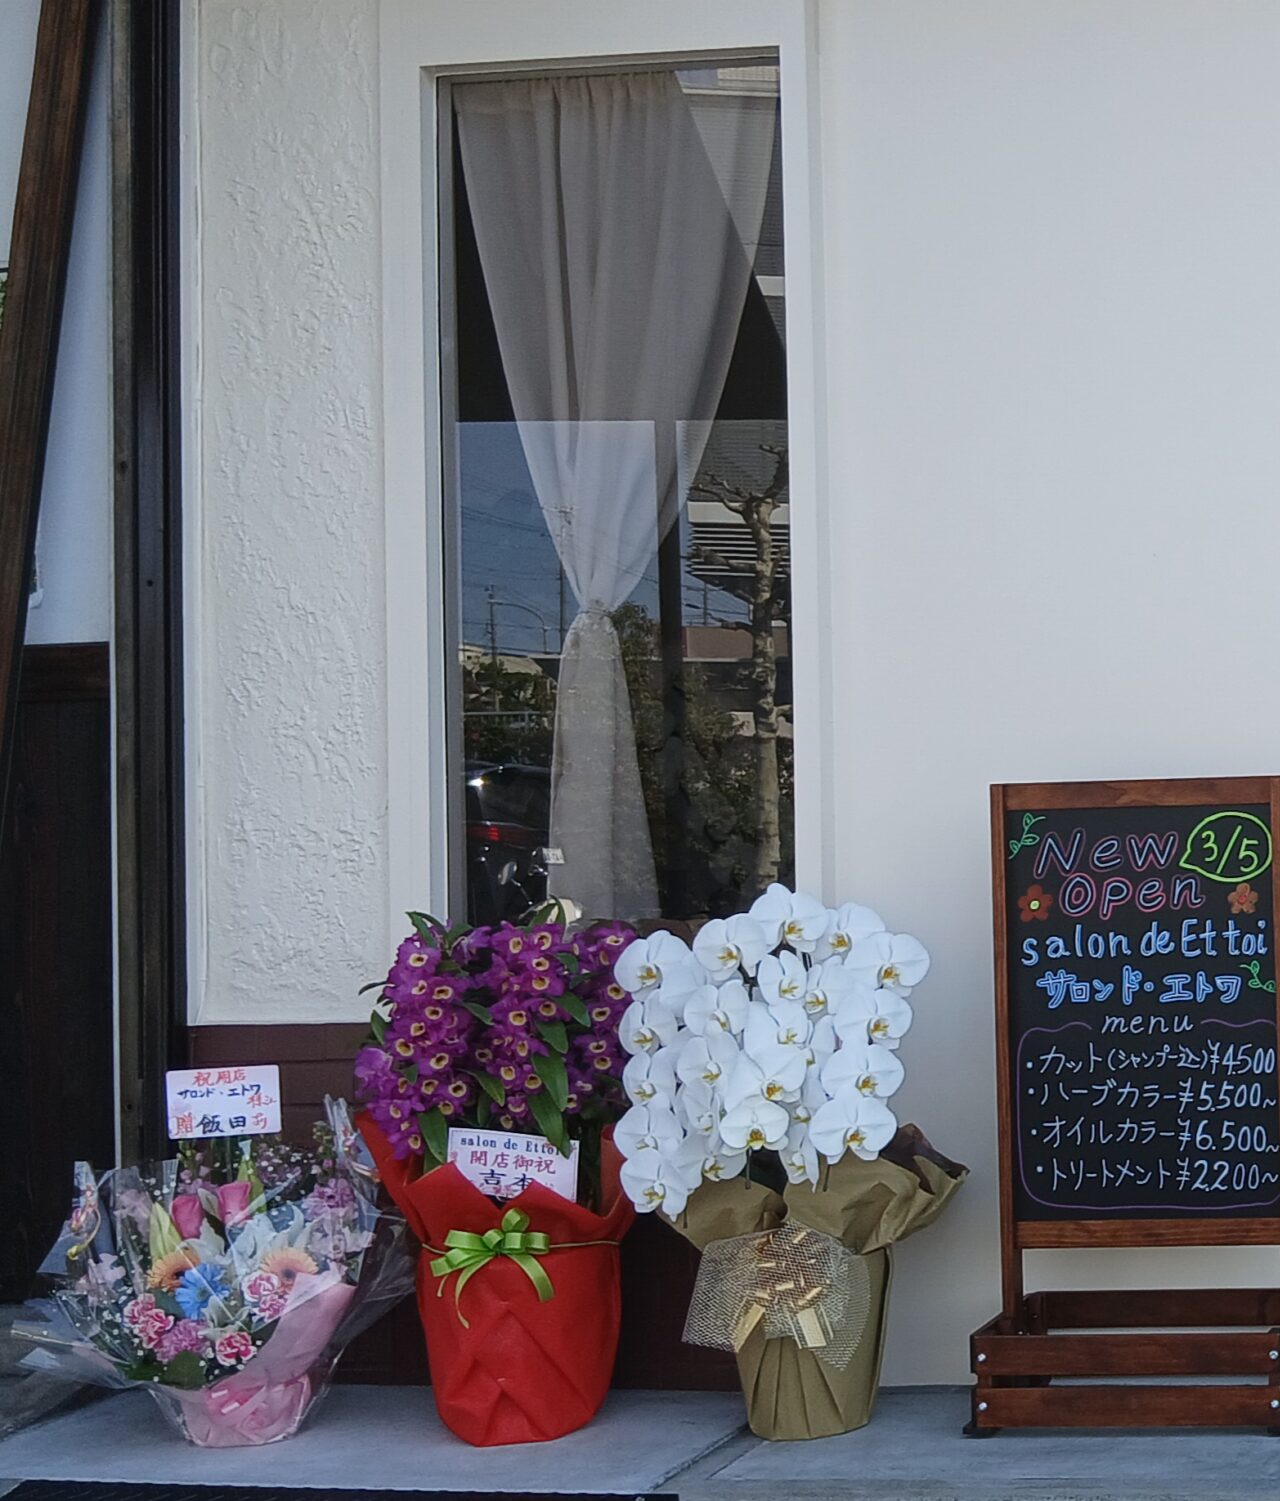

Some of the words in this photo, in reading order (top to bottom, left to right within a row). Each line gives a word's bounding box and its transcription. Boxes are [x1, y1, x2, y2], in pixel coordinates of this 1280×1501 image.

[1034, 828, 1179, 879] New
[1201, 825, 1259, 874] 3/5
[1021, 923, 1132, 966] salon
[1140, 921, 1175, 956] de
[1181, 918, 1269, 957] Ettoi
[1035, 964, 1243, 1009] サロンド・エトワ
[1101, 1013, 1195, 1035] menu
[460, 1135, 497, 1148] salon
[503, 1138, 519, 1150] de
[470, 1150, 556, 1175] 開店御祝
